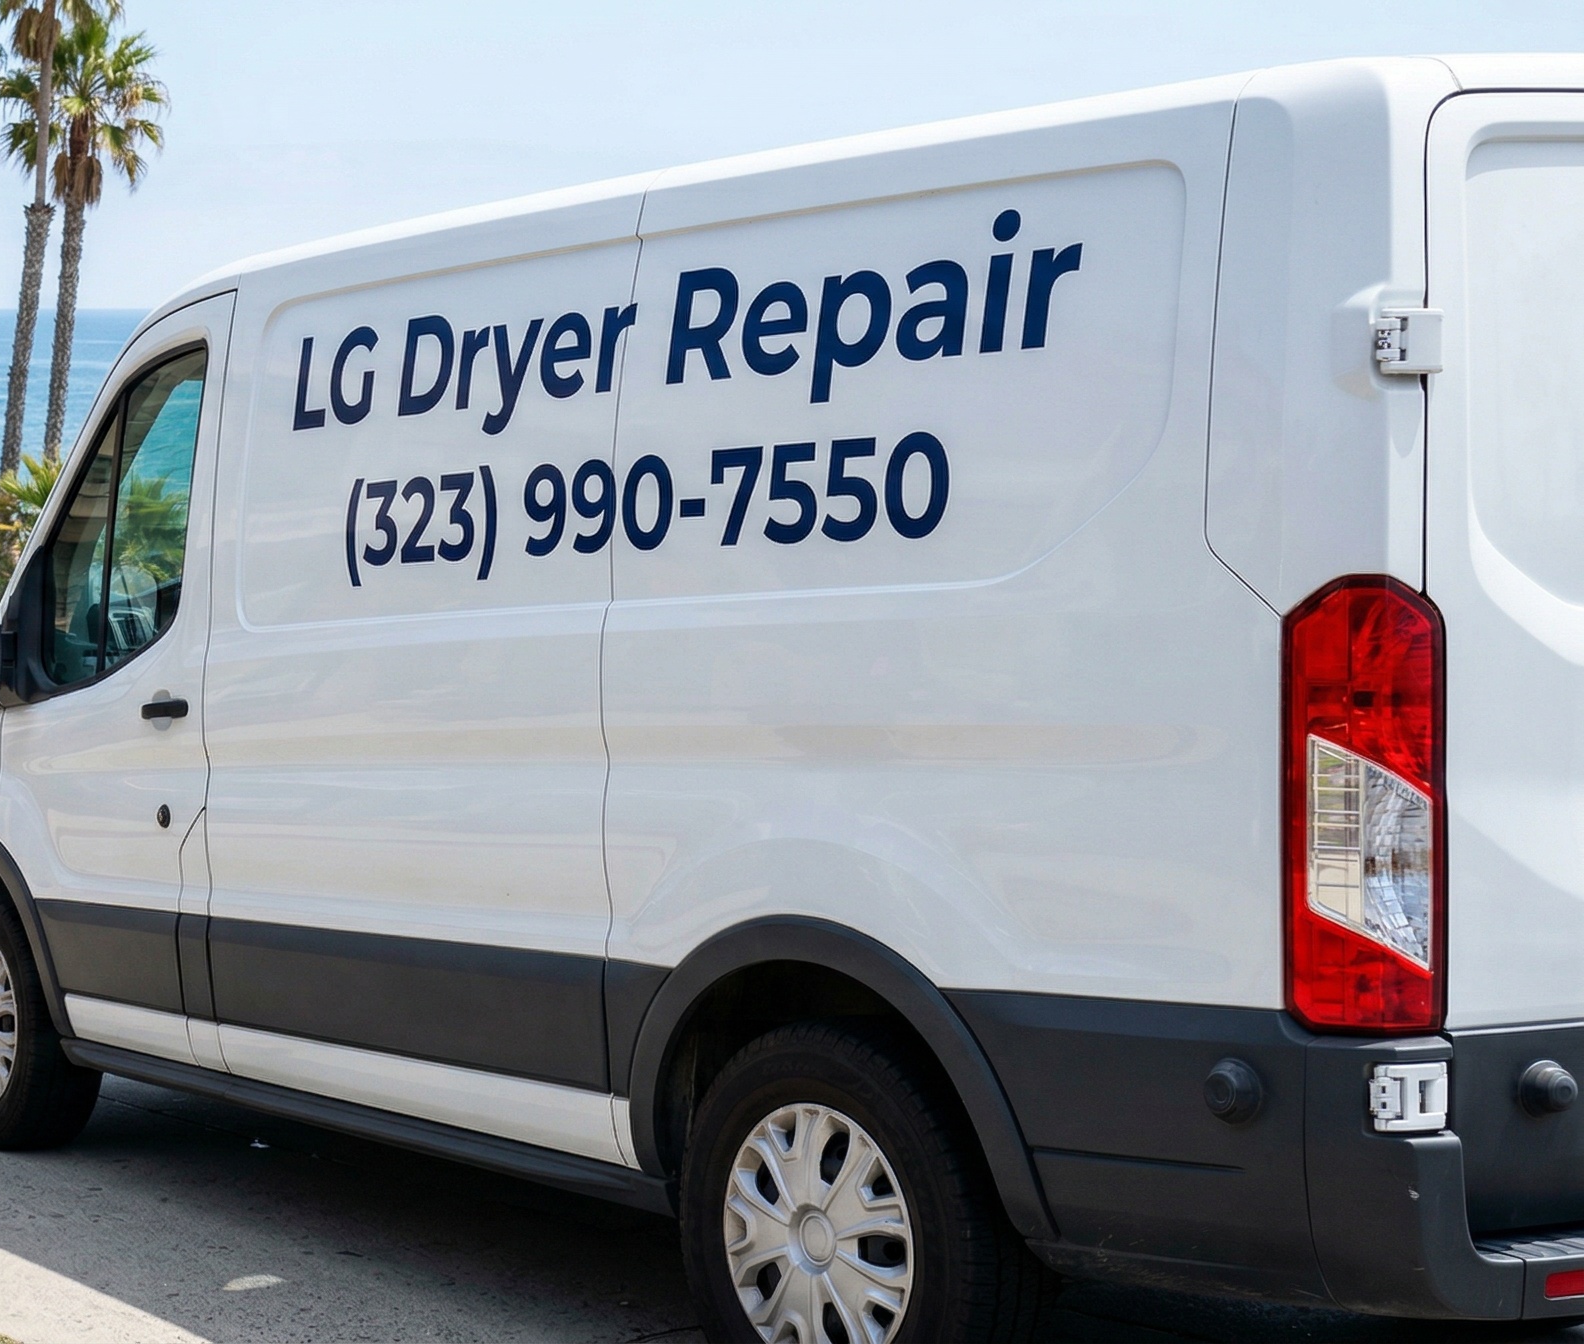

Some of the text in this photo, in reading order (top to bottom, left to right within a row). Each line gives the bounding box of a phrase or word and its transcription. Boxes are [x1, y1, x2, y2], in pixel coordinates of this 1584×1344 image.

[292, 208, 1083, 436] LG Dryer Repair
[345, 431, 950, 587] (323) 990-7550
